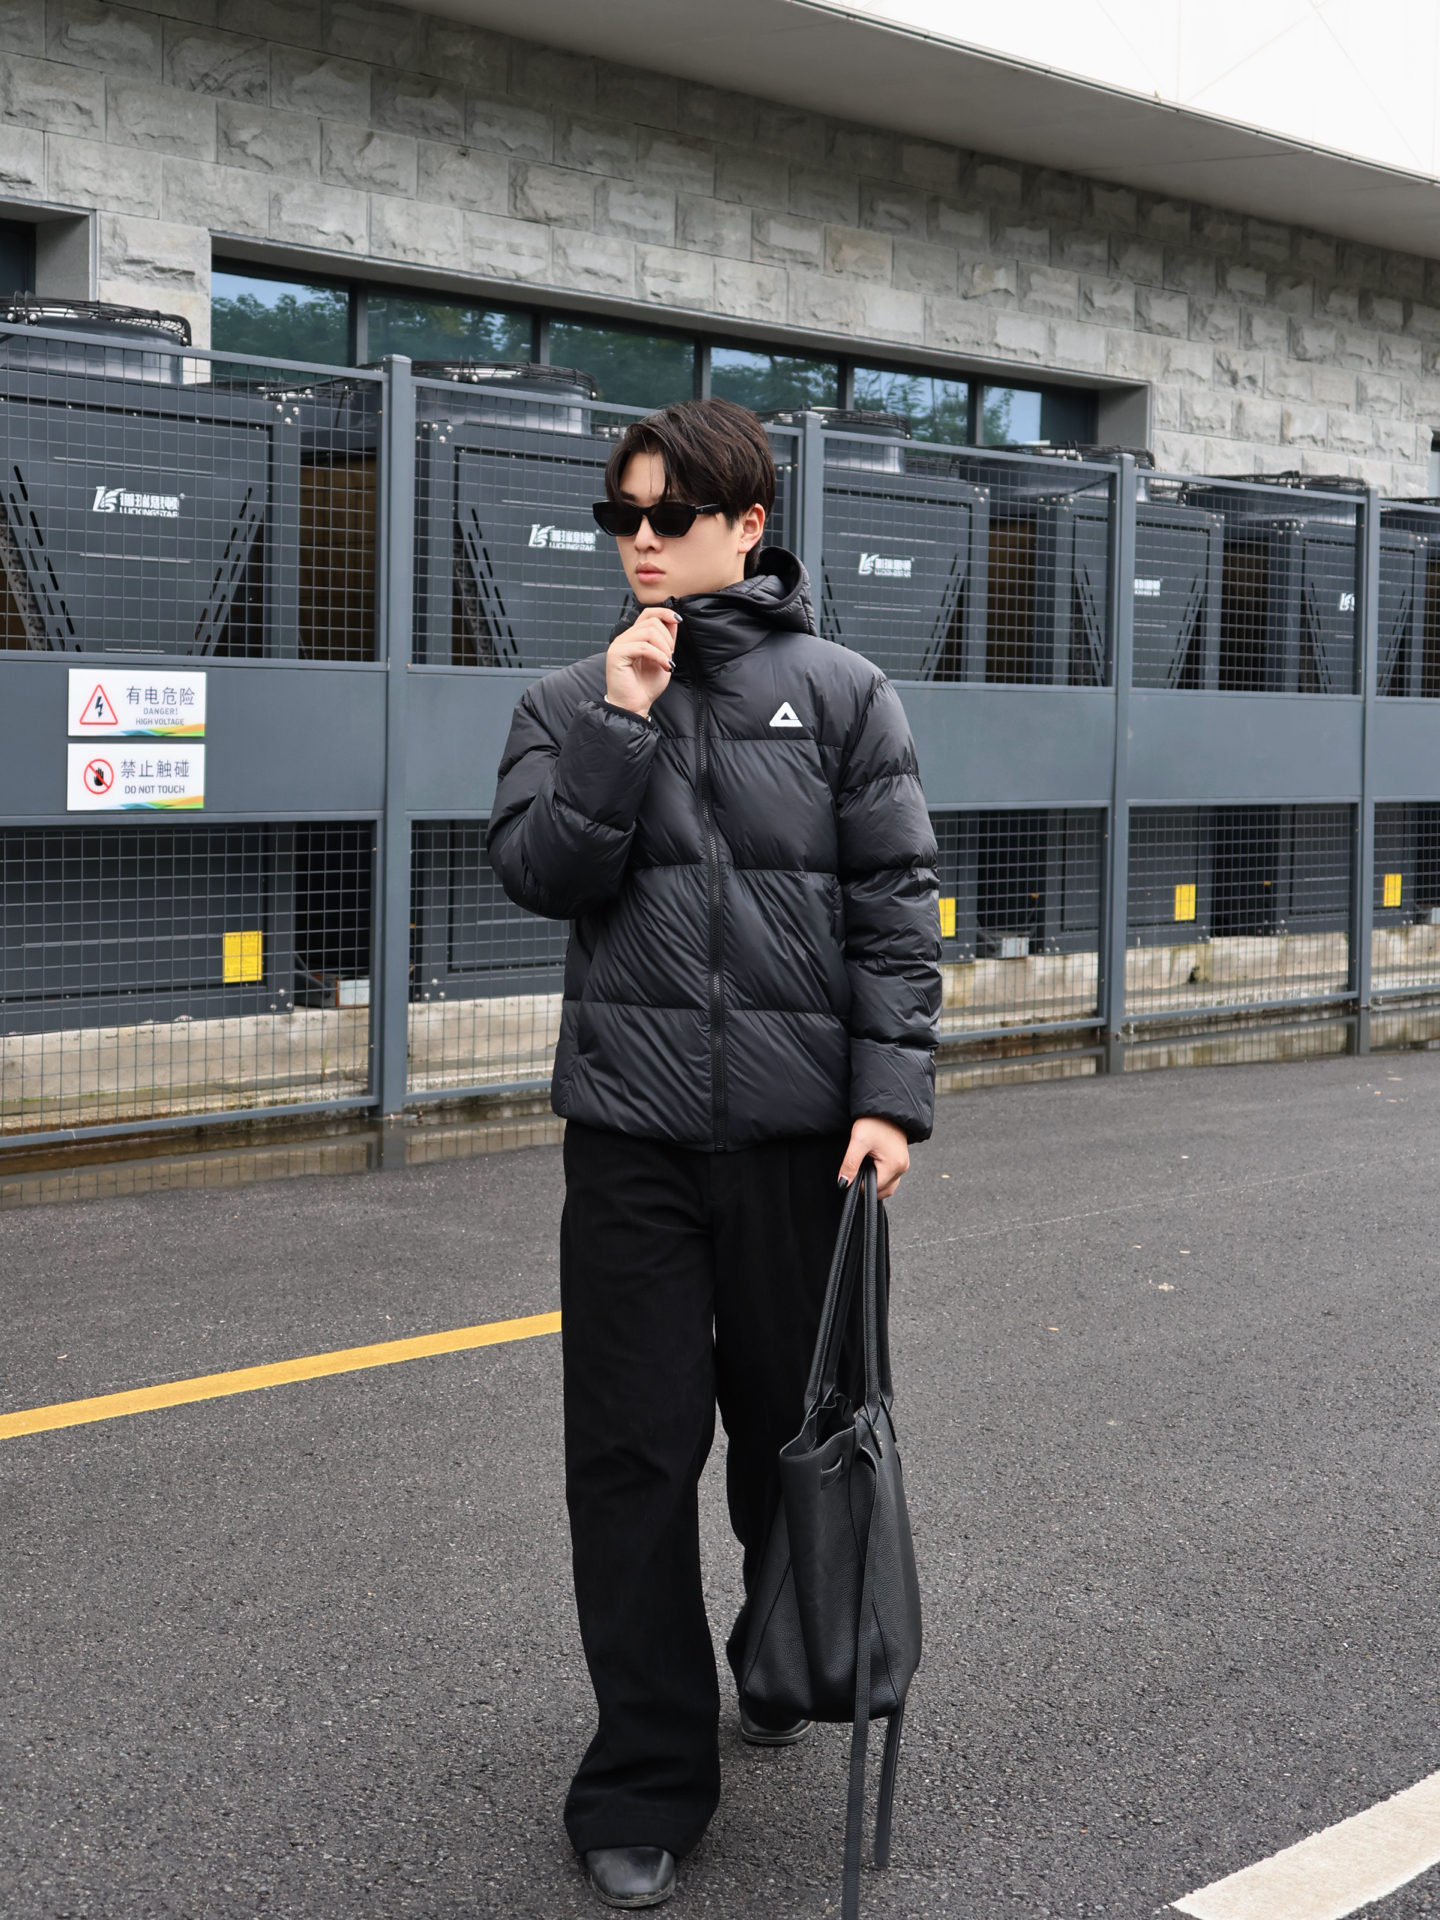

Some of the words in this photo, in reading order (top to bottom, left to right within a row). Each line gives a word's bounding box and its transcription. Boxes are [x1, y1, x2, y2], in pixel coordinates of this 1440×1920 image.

[119, 506, 180, 518] LUCKINGSTAR
[125, 685, 195, 706] 有电危险
[143, 707, 178, 715] DANGER!
[154, 718, 185, 726] VOLTAGE
[120, 759, 190, 779] 禁止触碰
[124, 785, 136, 794] DO
[138, 785, 156, 794] NOT
[157, 785, 185, 794] TOUCH
